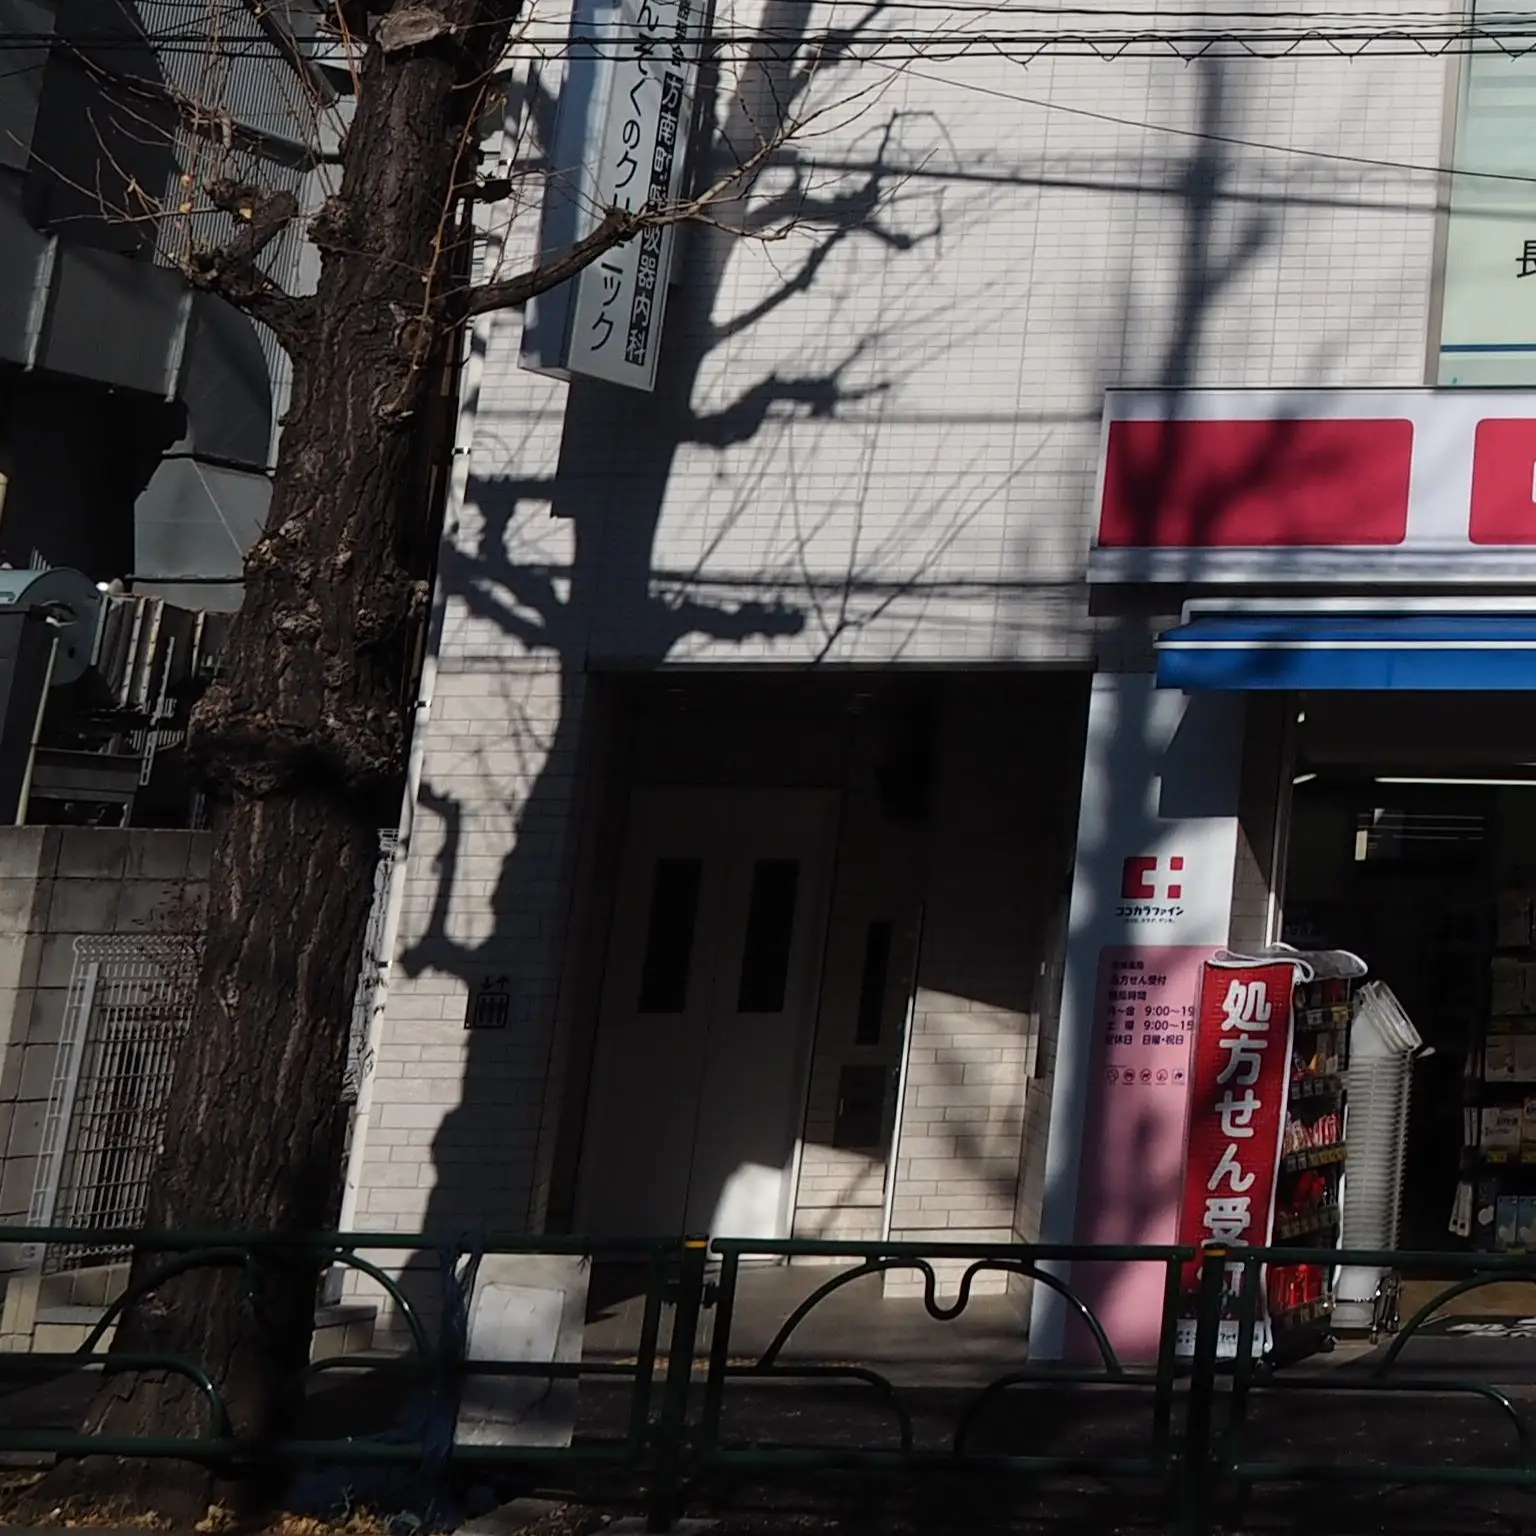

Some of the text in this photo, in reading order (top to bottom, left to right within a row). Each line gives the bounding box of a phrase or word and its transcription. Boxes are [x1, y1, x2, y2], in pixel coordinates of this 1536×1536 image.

[1115, 905, 1185, 917] ココカラファイン
[1199, 978, 1273, 1297] 処方せん受
